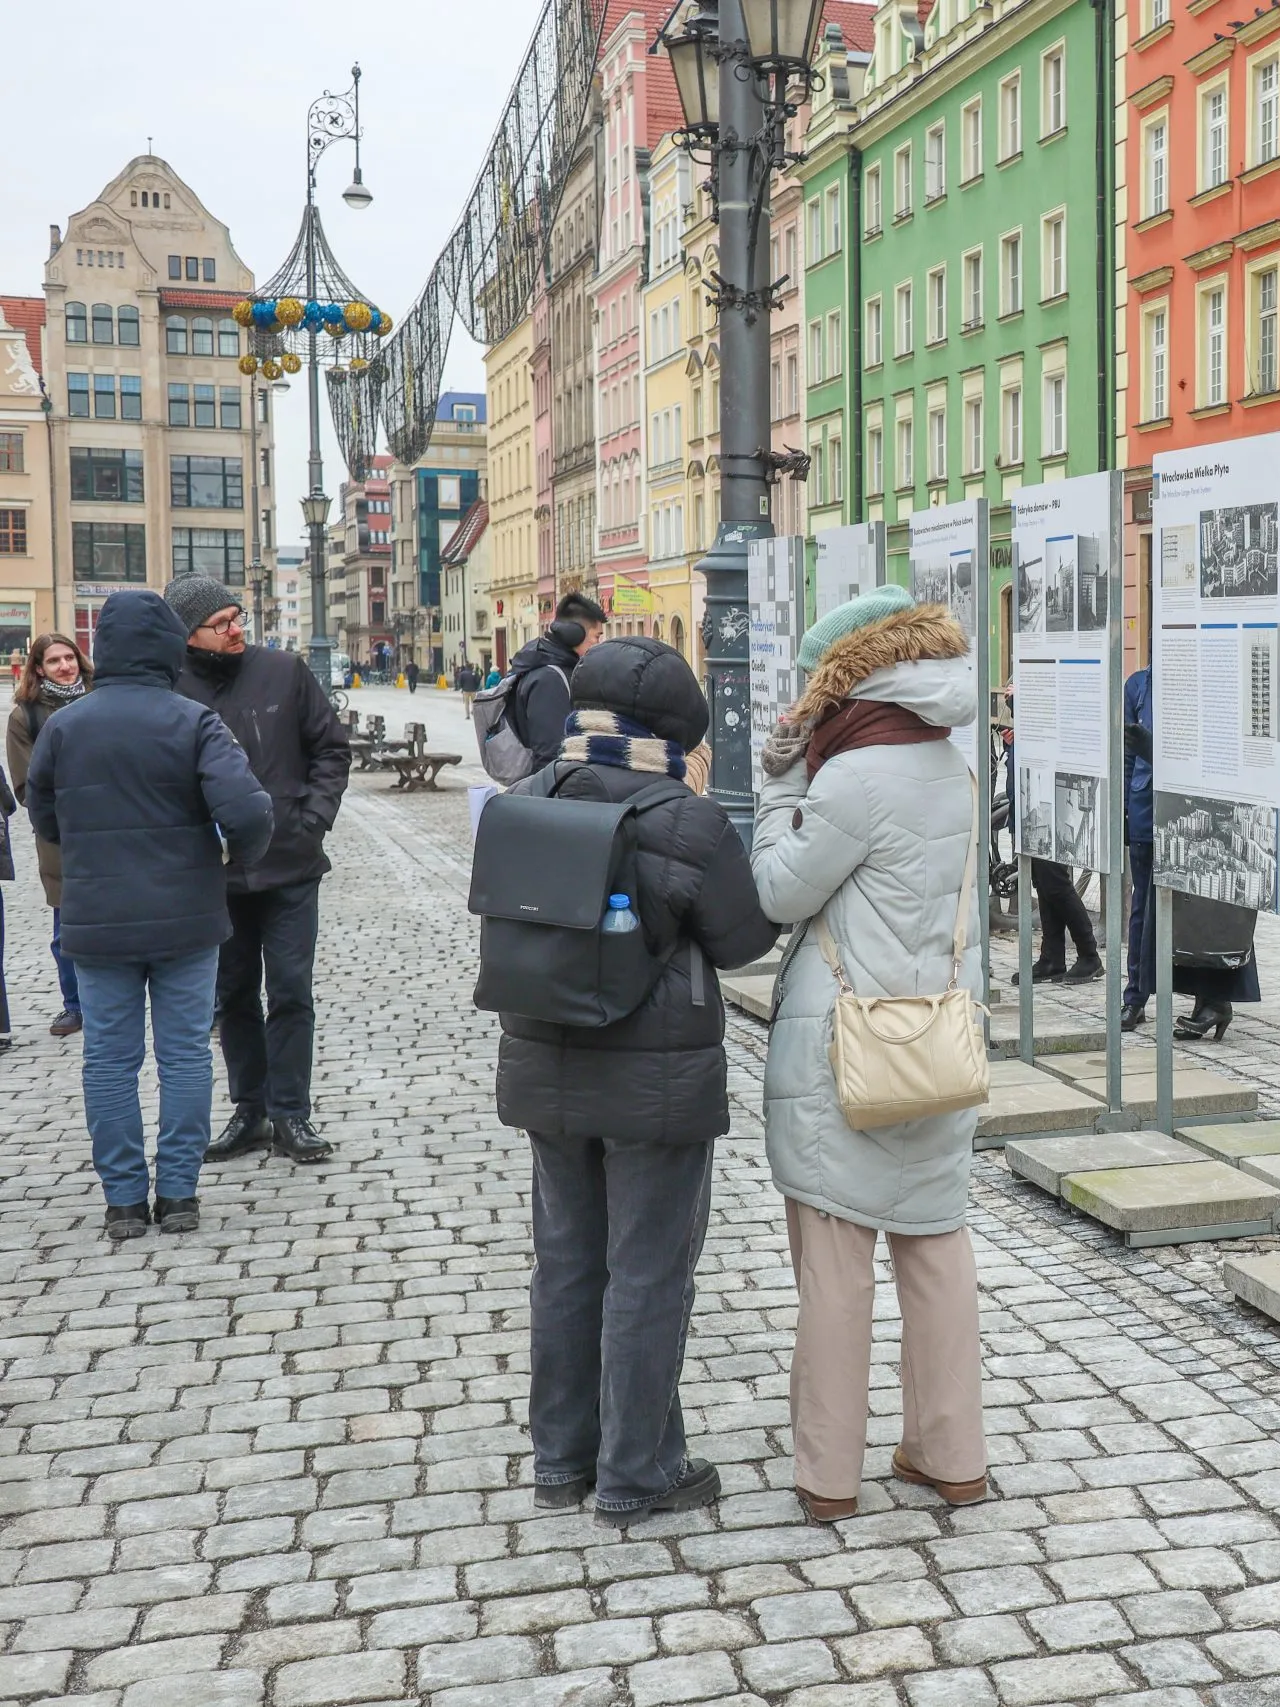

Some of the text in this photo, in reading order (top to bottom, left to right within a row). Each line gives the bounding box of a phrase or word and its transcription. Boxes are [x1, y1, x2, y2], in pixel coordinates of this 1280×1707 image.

[1161, 463, 1230, 484] Wrocławska Wielka Płyta
[755, 679, 769, 696] wielkiej
